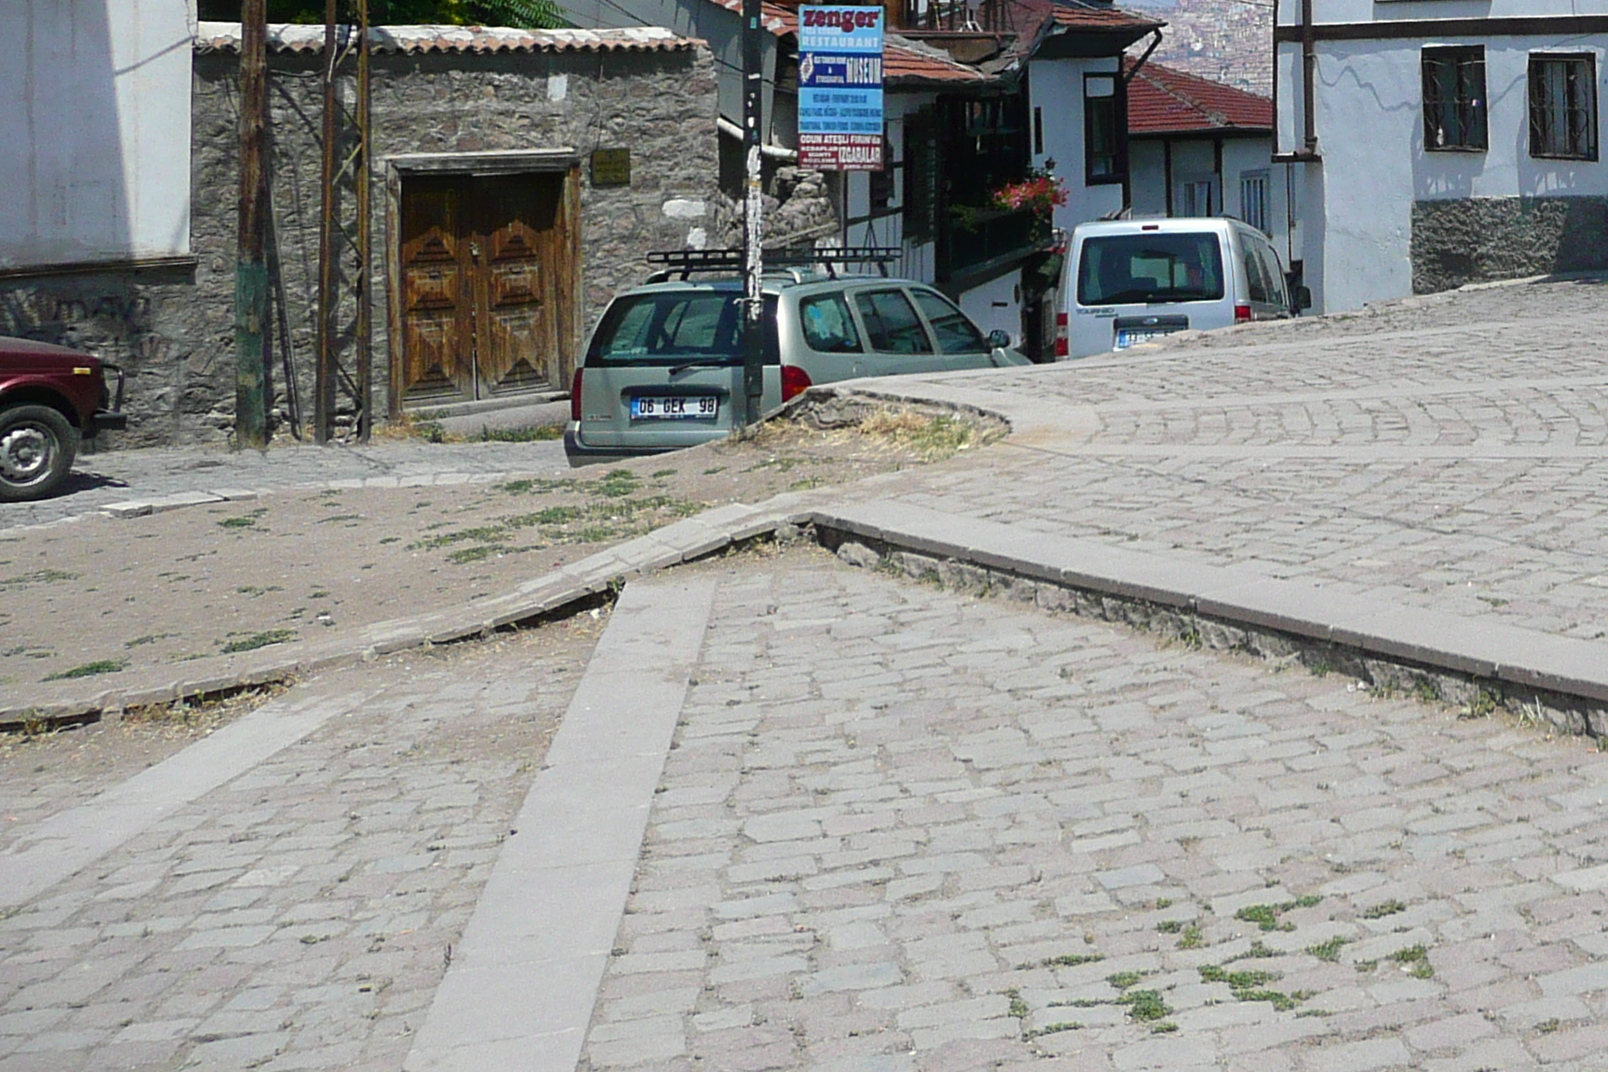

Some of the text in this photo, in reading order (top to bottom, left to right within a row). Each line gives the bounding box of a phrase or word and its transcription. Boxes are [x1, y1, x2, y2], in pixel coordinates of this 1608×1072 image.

[803, 9, 879, 33] zenger
[802, 36, 879, 47] RESTAURANT
[846, 57, 881, 84] MUSEUM
[800, 134, 823, 144] ODUN
[639, 398, 715, 414] 06 GEK 98
